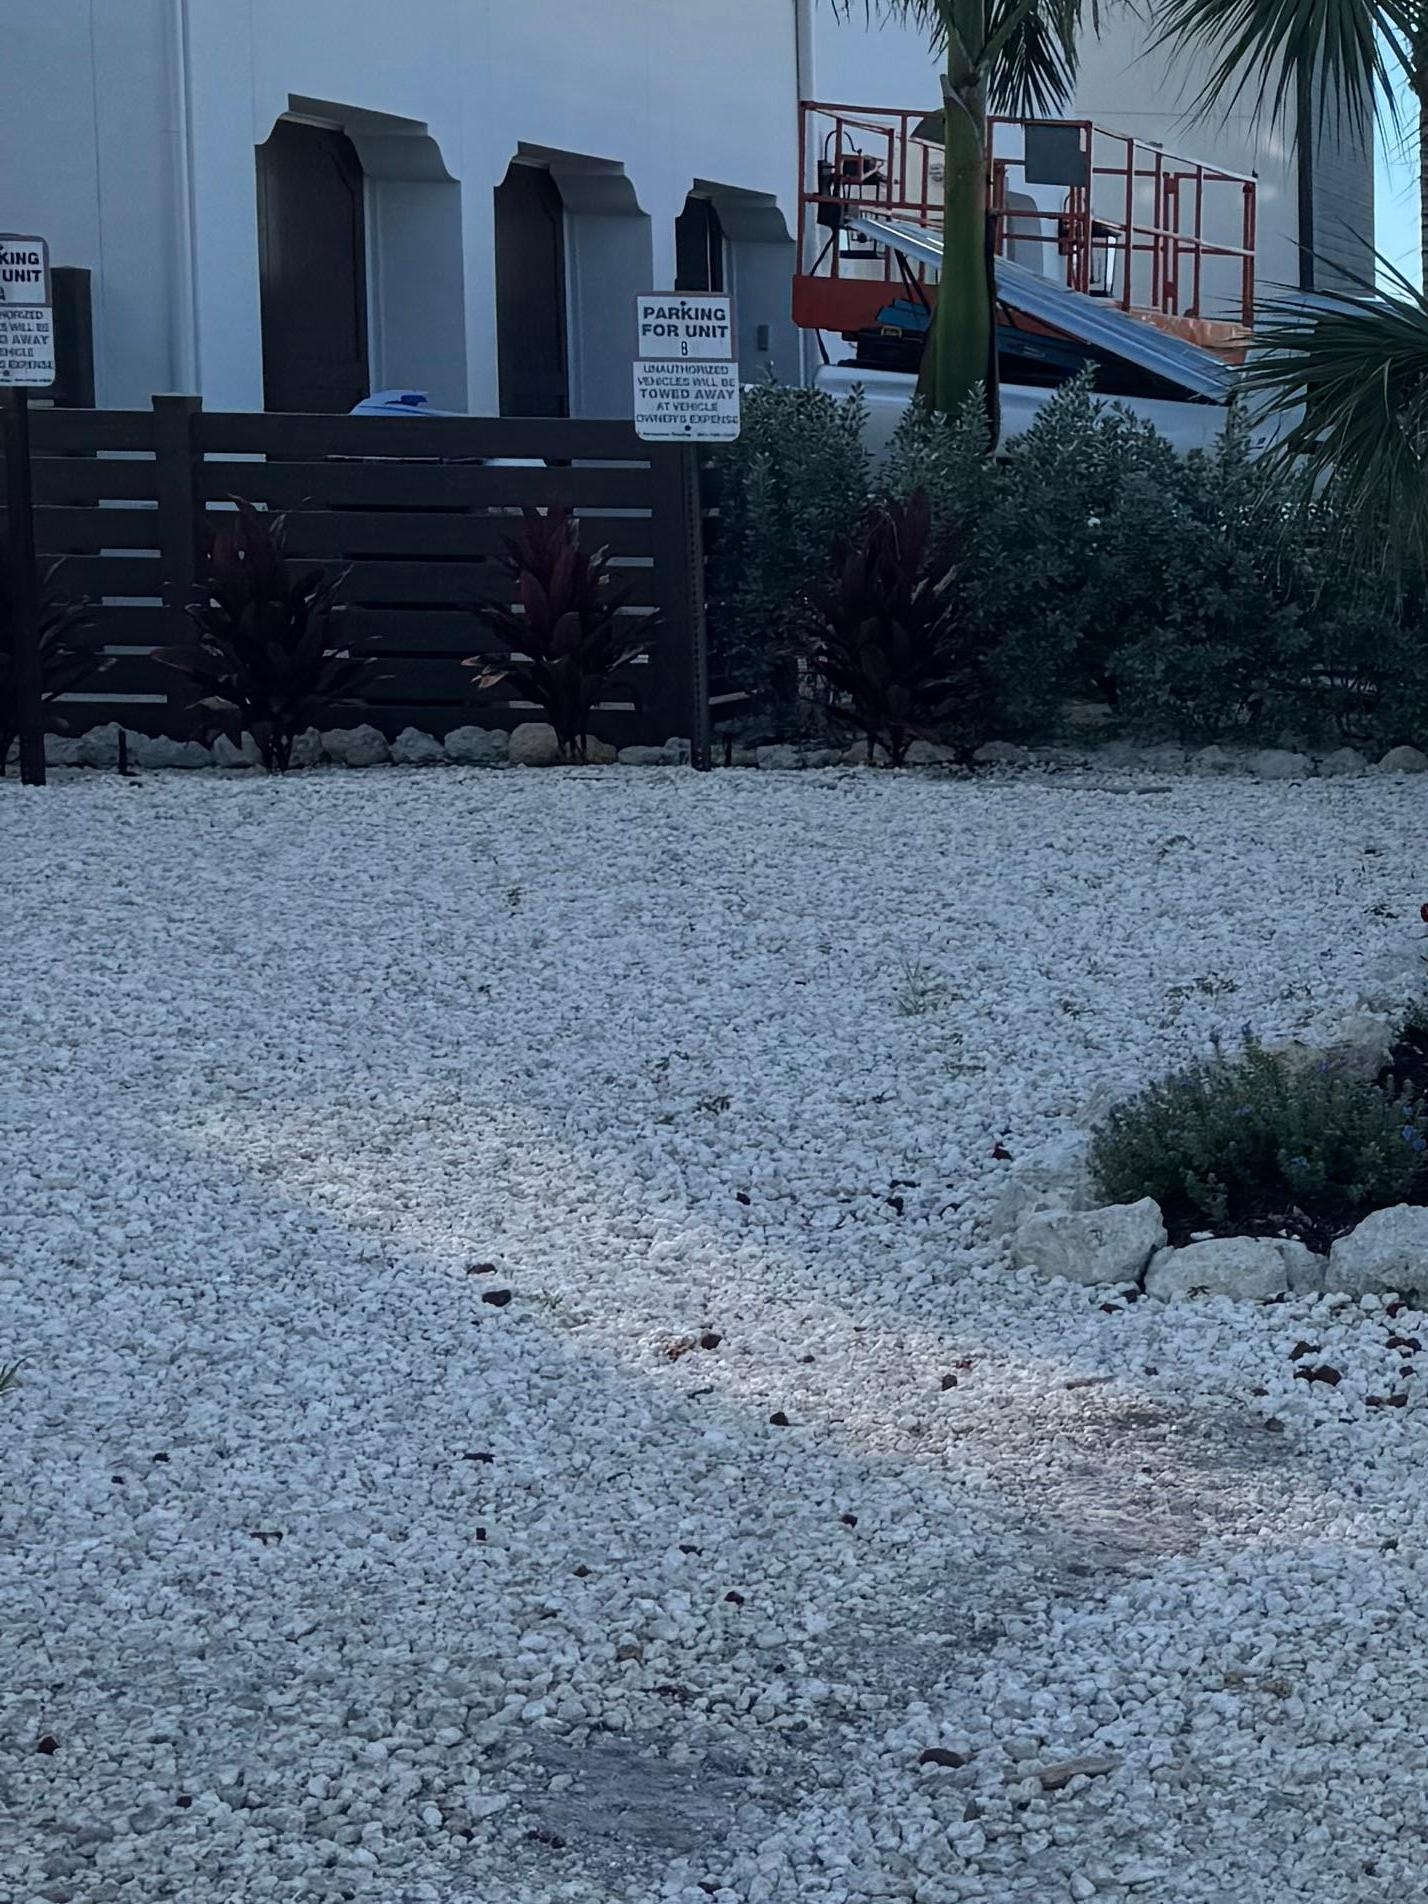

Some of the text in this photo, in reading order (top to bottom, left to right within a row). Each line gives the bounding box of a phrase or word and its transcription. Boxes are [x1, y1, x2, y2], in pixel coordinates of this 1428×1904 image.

[0, 252, 39, 265] KING
[2, 269, 42, 282] UNIT
[643, 306, 726, 321] PARKING
[642, 324, 728, 338] FOR UNIT
[12, 335, 49, 344] AWAY
[692, 377, 718, 387] WILL
[640, 388, 735, 400] TOWED AWAY
[657, 402, 669, 411] AT
